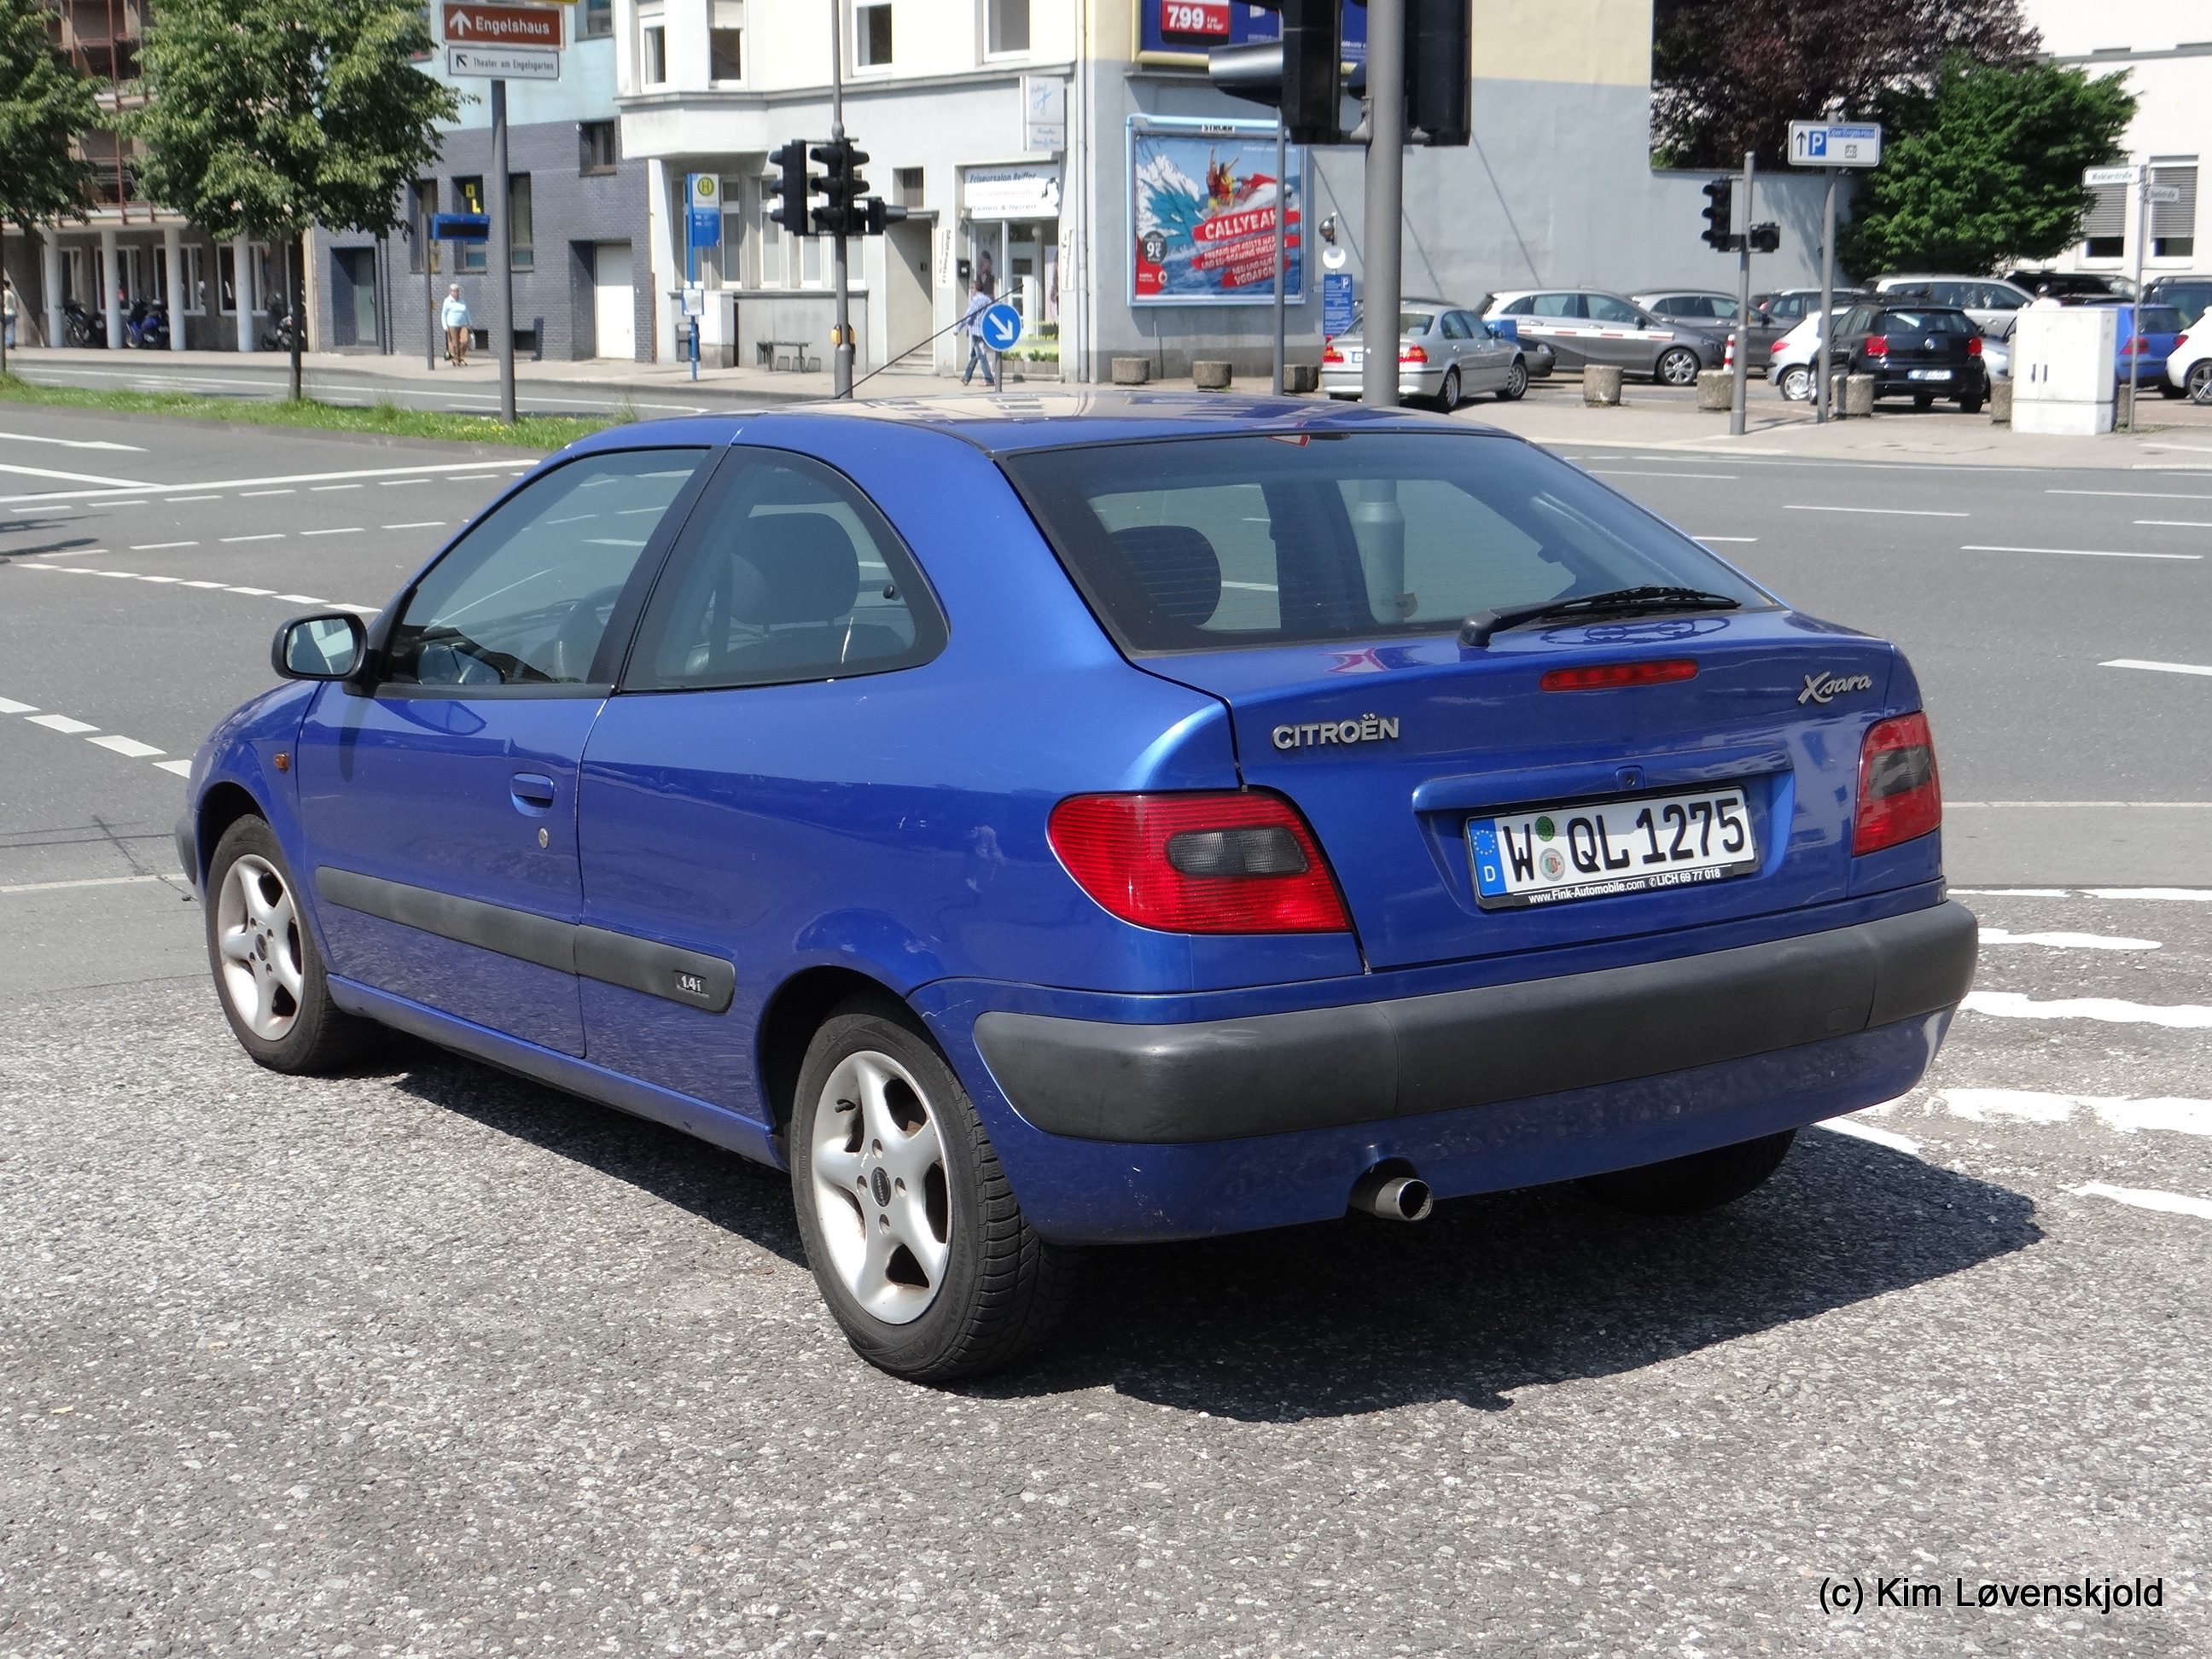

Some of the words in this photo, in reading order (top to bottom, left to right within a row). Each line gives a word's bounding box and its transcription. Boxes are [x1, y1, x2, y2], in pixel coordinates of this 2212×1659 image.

[475, 15, 550, 35] Engelshaus
[474, 57, 497, 68] Theater
[514, 60, 554, 72] Engelsgarten
[1812, 132, 1824, 154] P
[701, 181, 709, 192] H
[969, 172, 1011, 183] Friseursalon
[1234, 265, 1275, 285] VODAFON
[1797, 671, 1872, 704] Xsara
[1272, 713, 1399, 749] CITROËN
[1503, 824, 1534, 882] W
[1567, 814, 1631, 873] QL
[1636, 797, 1745, 864] 1275
[1483, 865, 1496, 882] D
[1528, 878, 1645, 904] www.Fink-Automobile.com
[1679, 871, 1691, 883] 69
[1691, 870, 1703, 882] 77
[1705, 869, 1720, 880] 018
